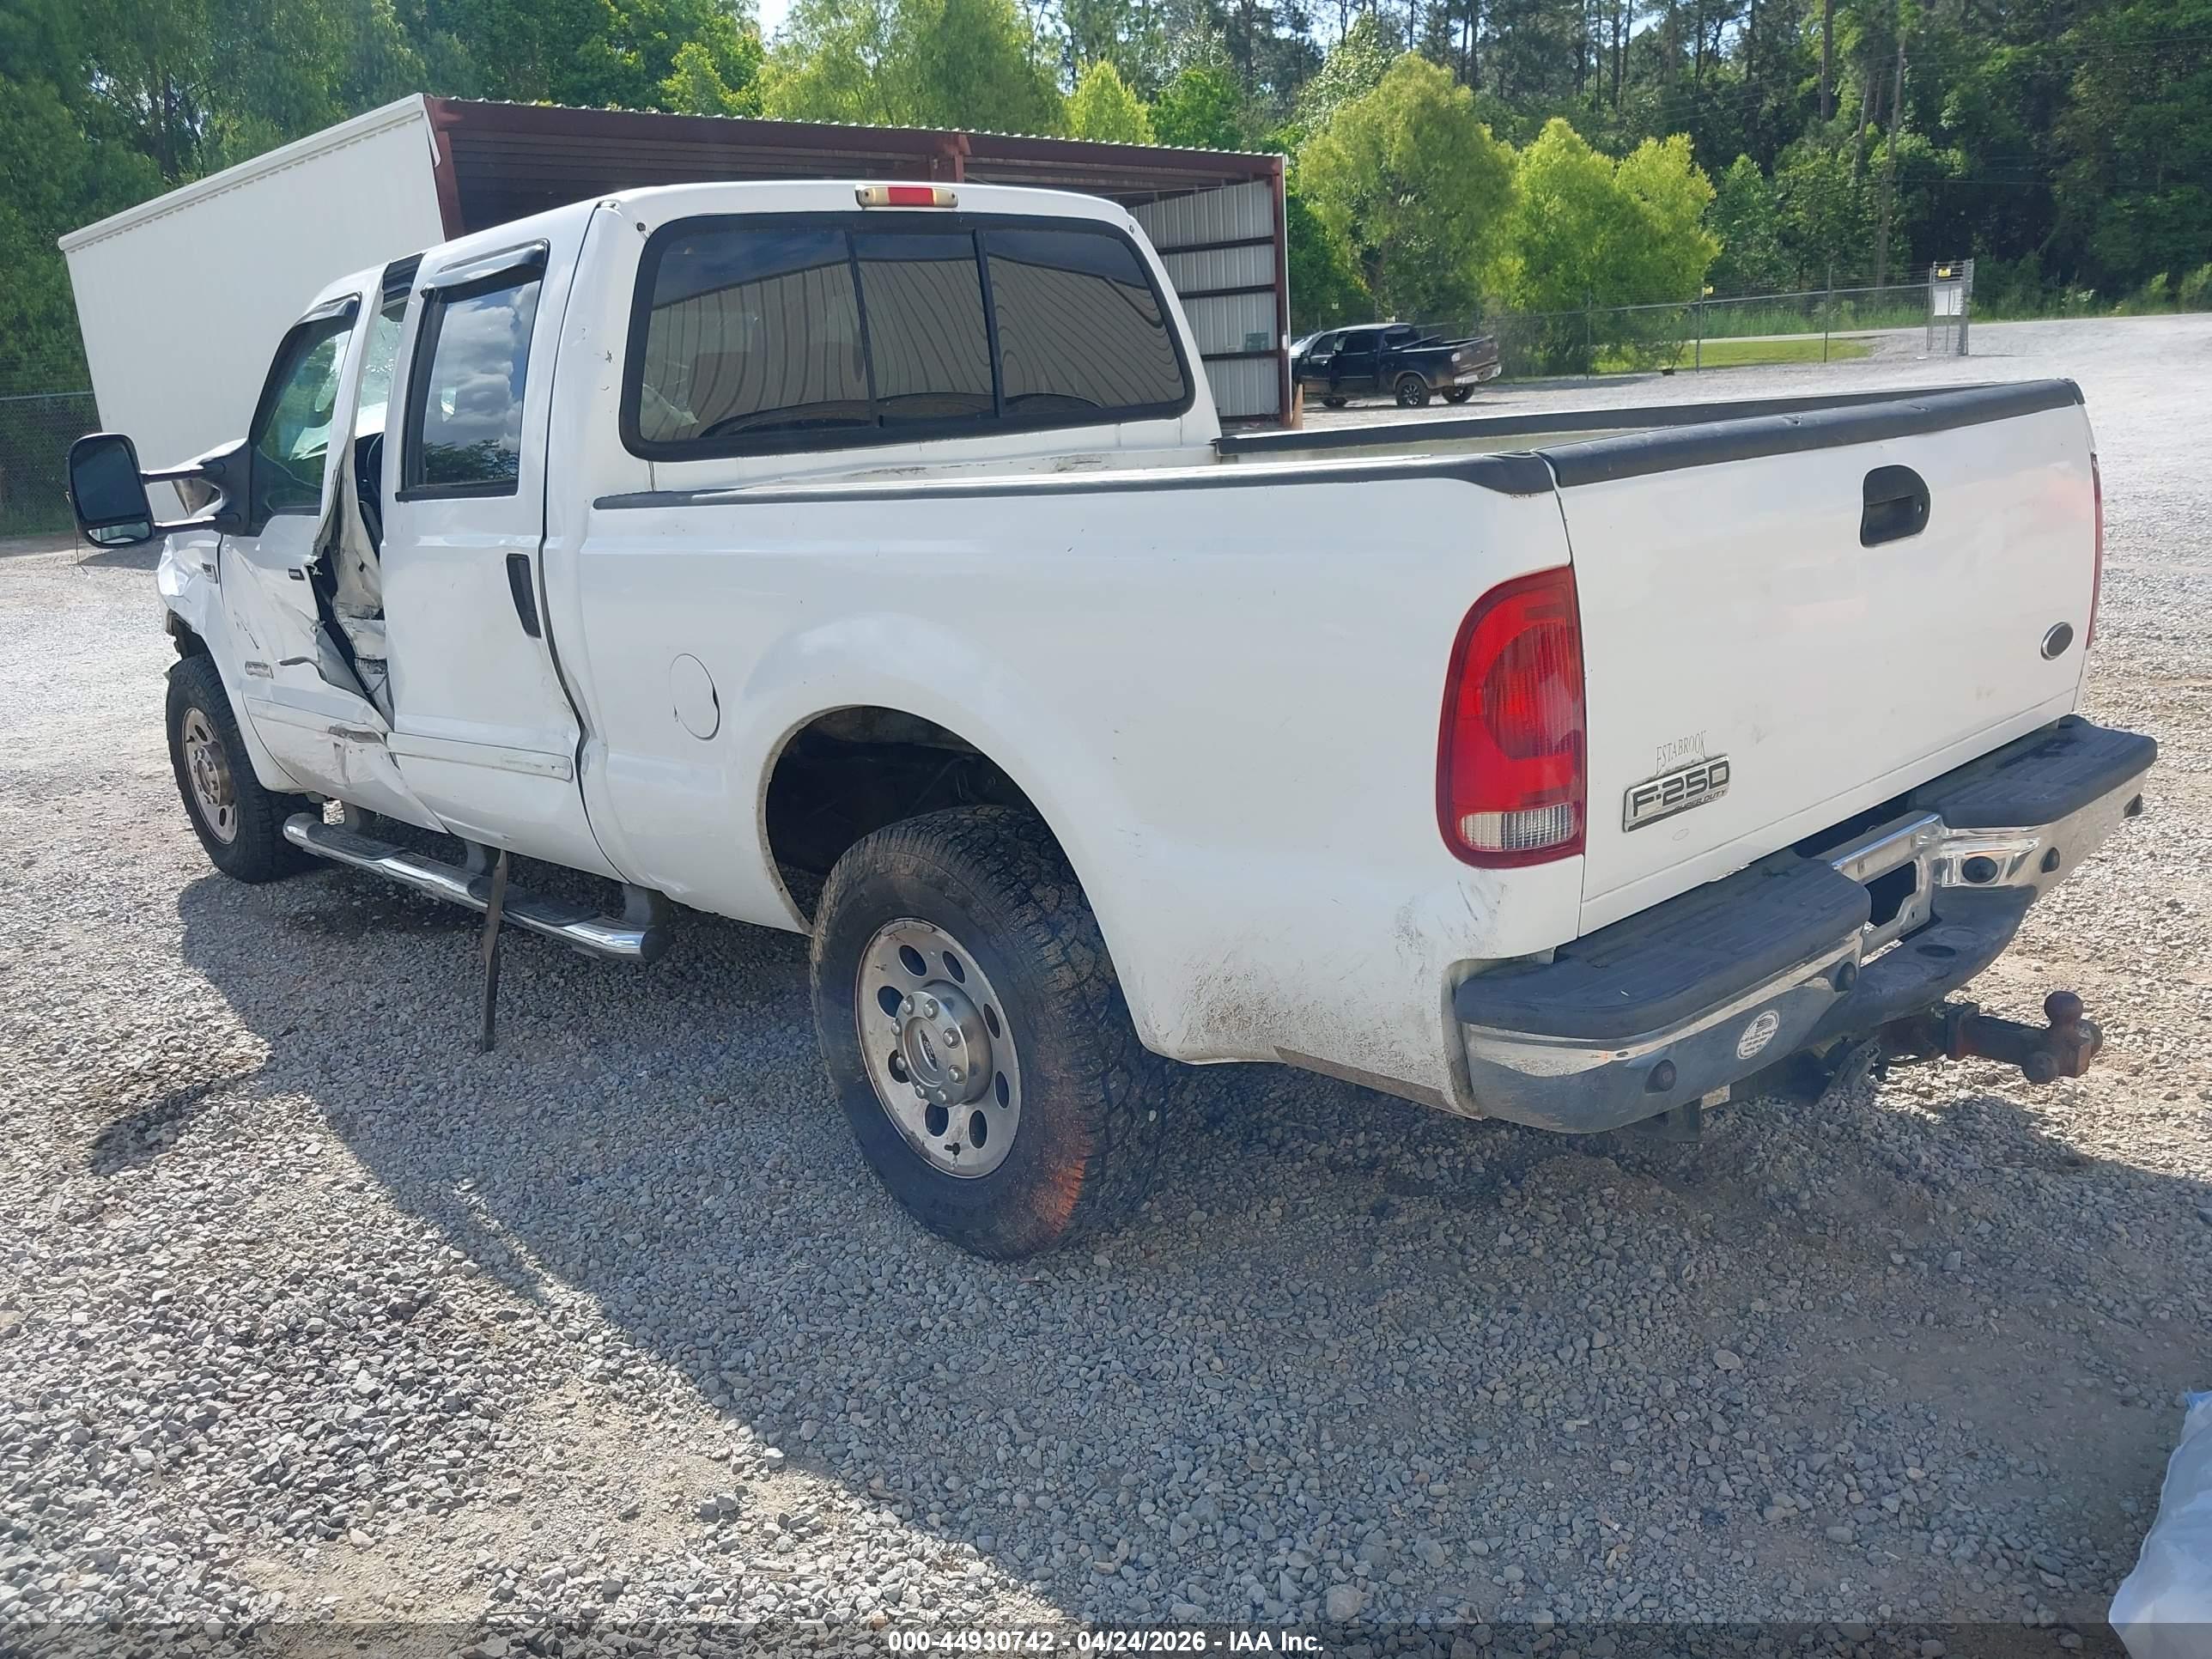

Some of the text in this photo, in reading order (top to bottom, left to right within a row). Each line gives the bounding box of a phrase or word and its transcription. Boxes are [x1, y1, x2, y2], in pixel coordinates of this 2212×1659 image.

[1656, 730, 1707, 776] ESTABROOK
[1632, 760, 1730, 817] F-250
[1702, 788, 1727, 803] DUTY
